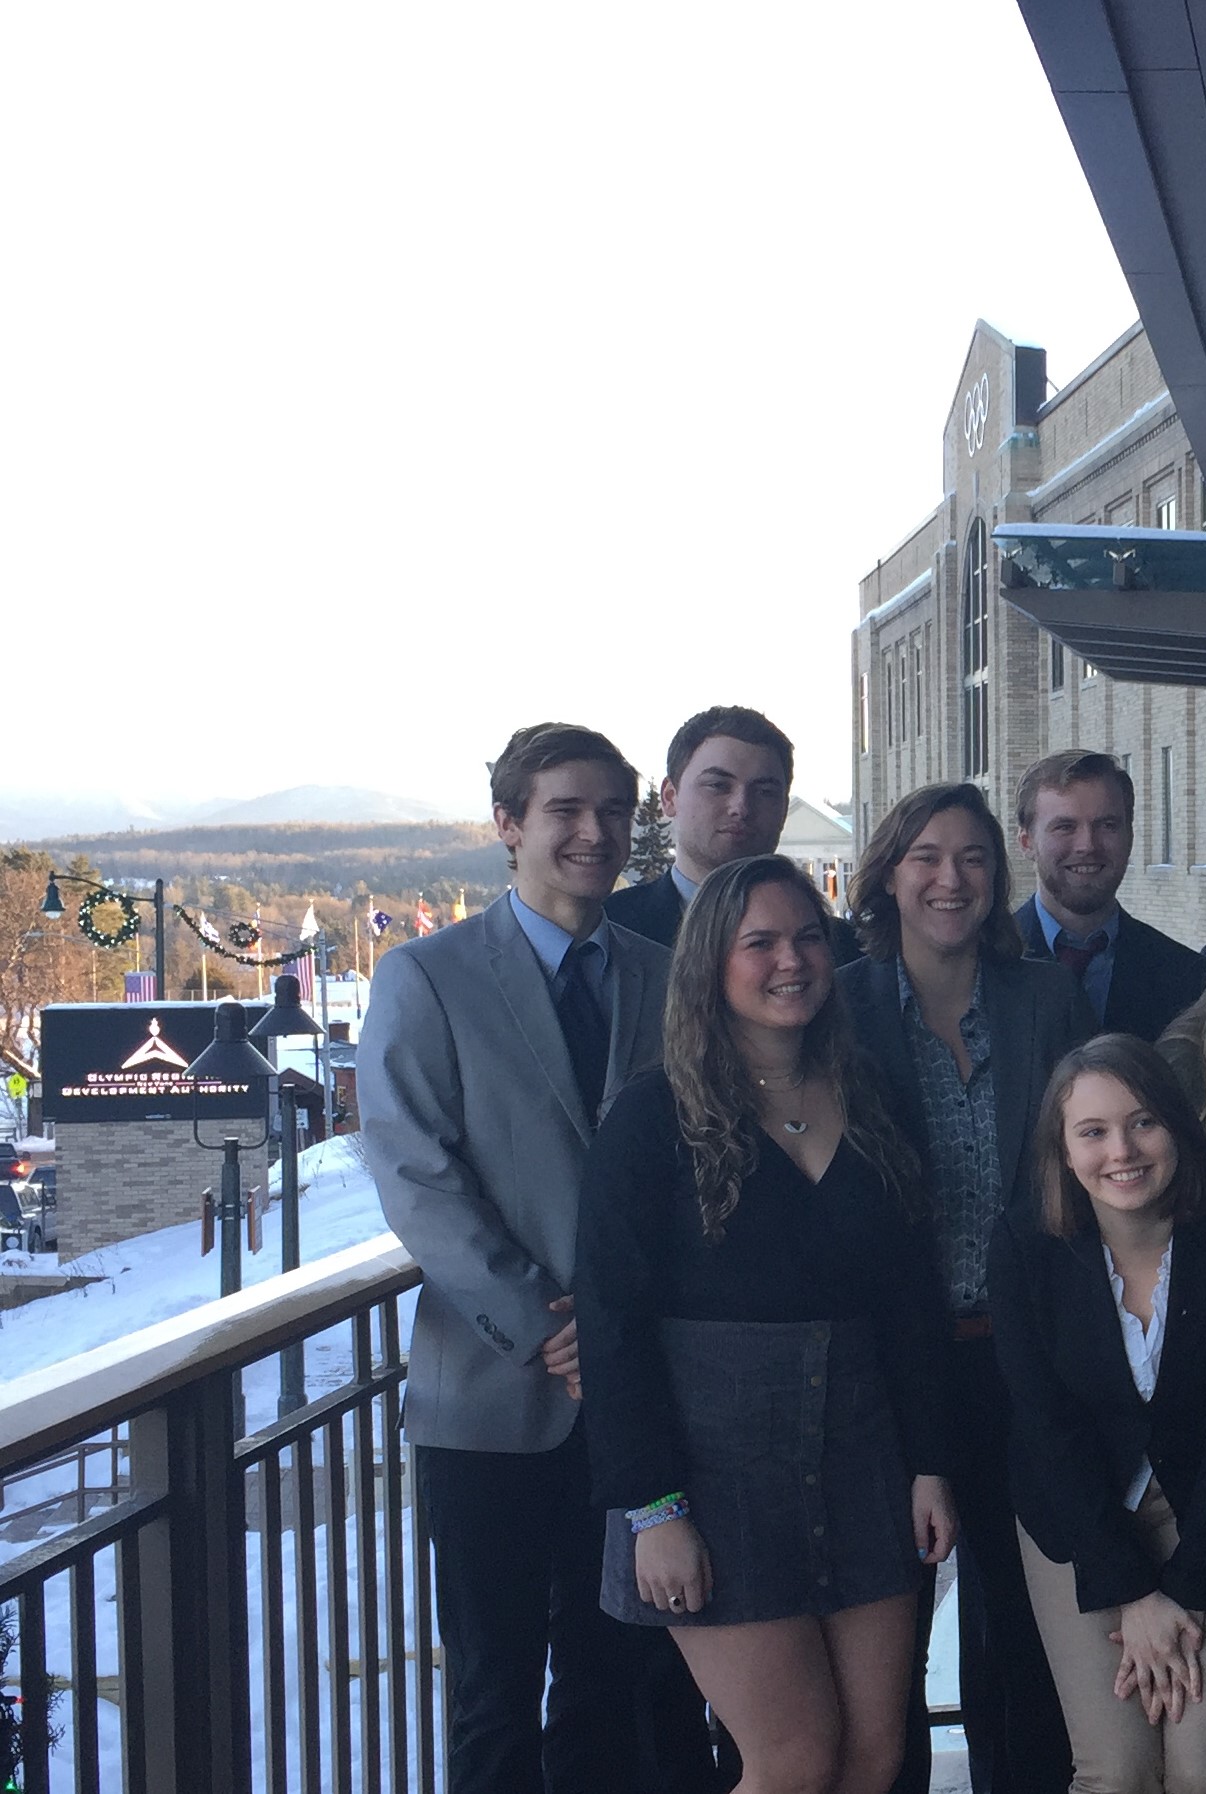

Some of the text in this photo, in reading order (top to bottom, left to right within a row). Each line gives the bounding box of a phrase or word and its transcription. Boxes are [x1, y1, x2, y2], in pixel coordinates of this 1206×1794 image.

[88, 1072, 221, 1082] OLYMPIC REGIO
[62, 1086, 165, 1096] DEVELOPMENT
